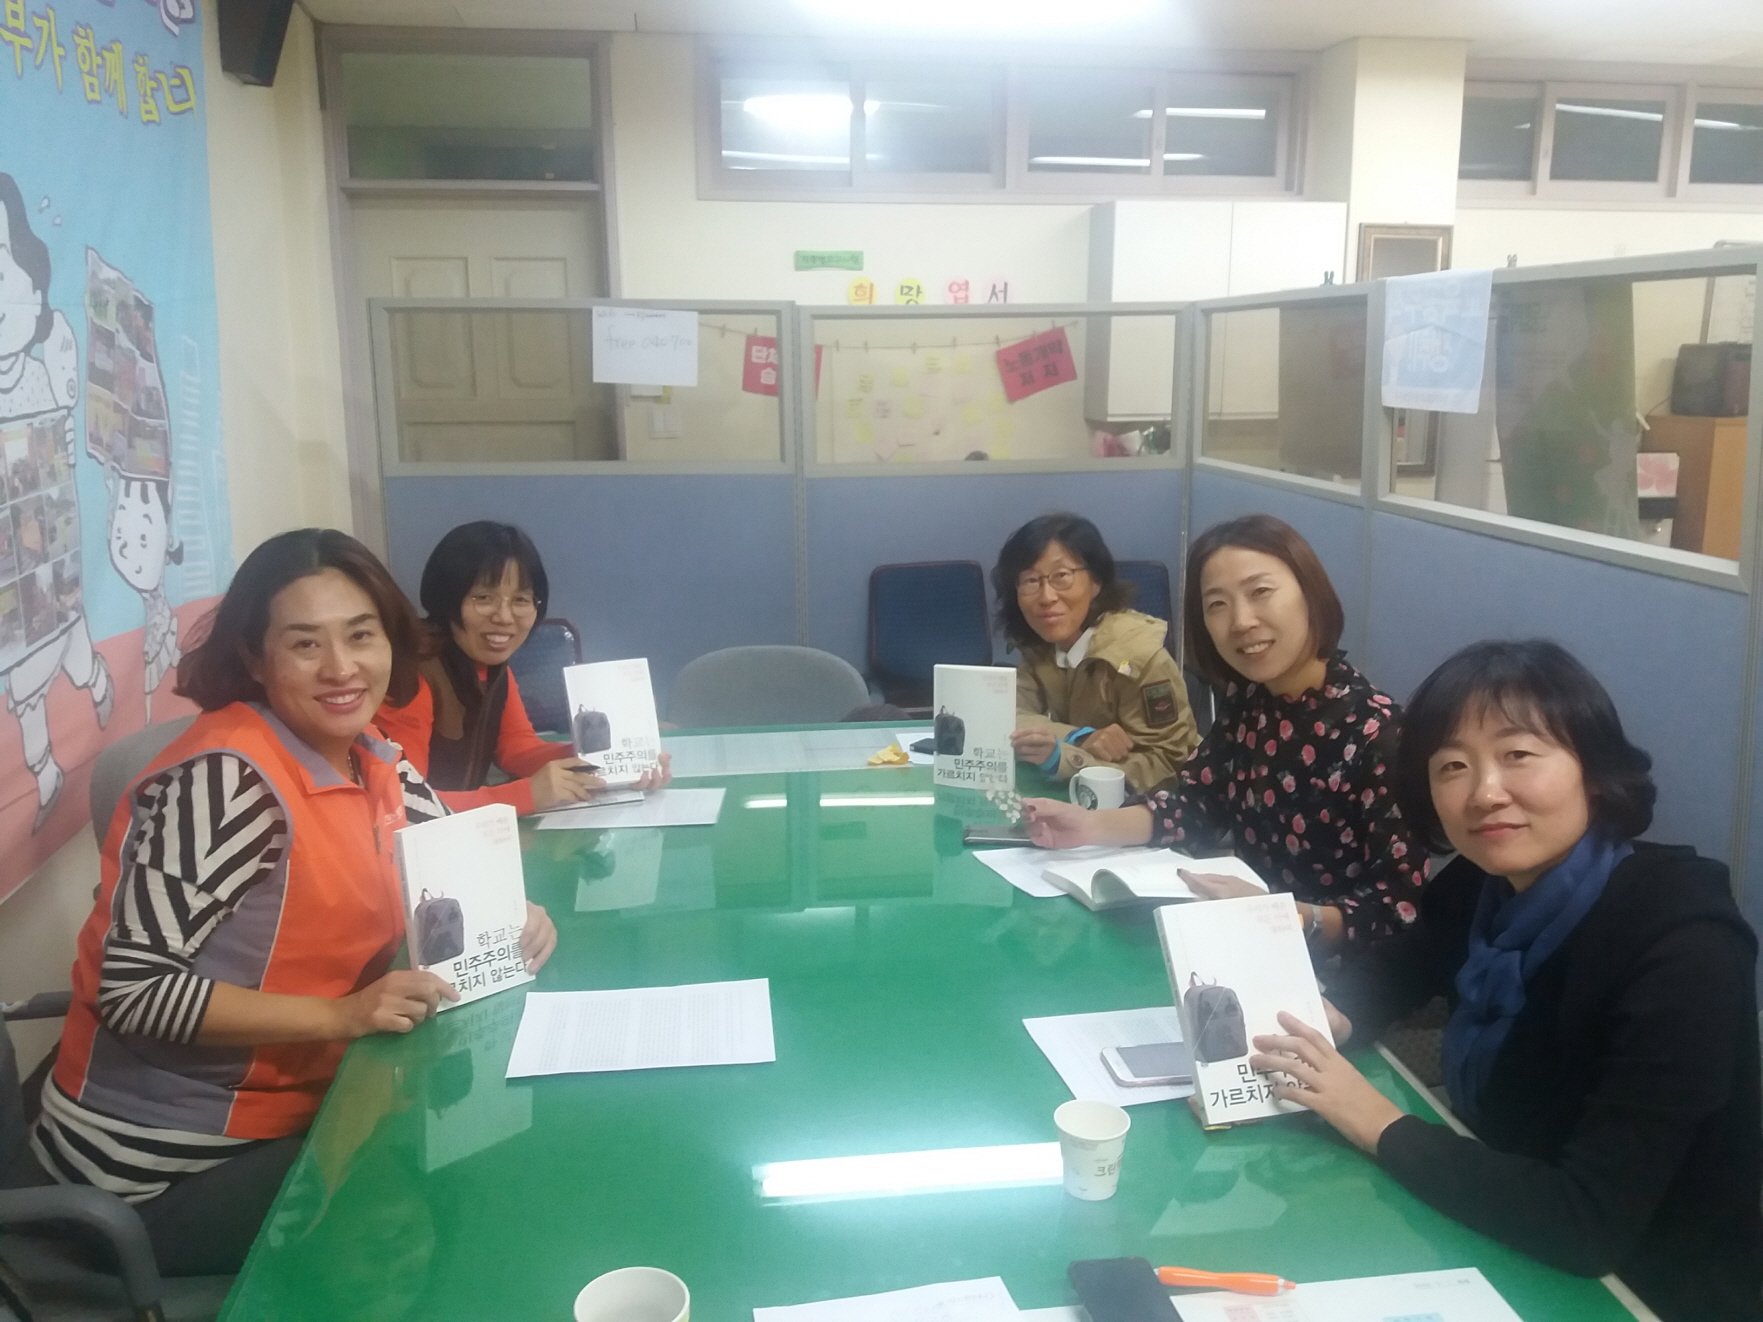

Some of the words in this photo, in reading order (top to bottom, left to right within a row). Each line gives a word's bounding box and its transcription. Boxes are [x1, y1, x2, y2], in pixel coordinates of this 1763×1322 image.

[71, 21, 128, 118] 함께
[602, 748, 656, 765] 민주주의를
[953, 758, 1008, 773] 민주주의를
[597, 763, 629, 776] 르치지
[937, 768, 976, 782] 가르치지
[476, 923, 522, 949] 학교는
[452, 941, 523, 978] 민주주의를
[490, 960, 527, 983] 않는다
